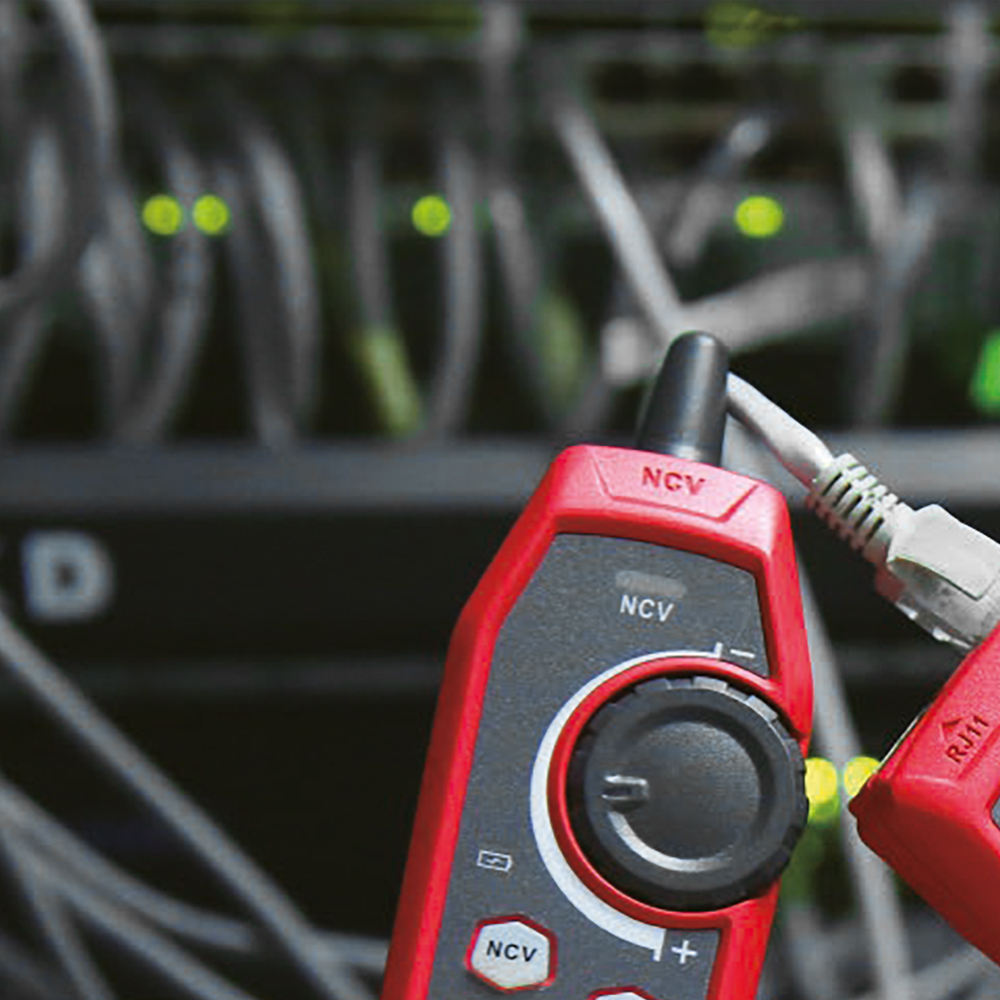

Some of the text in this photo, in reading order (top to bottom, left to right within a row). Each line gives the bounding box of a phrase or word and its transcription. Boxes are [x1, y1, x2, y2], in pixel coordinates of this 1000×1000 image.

[641, 466, 706, 495] NCV
[620, 594, 674, 622] NCV
[946, 714, 989, 764] RJ11
[486, 940, 537, 962] NCV
